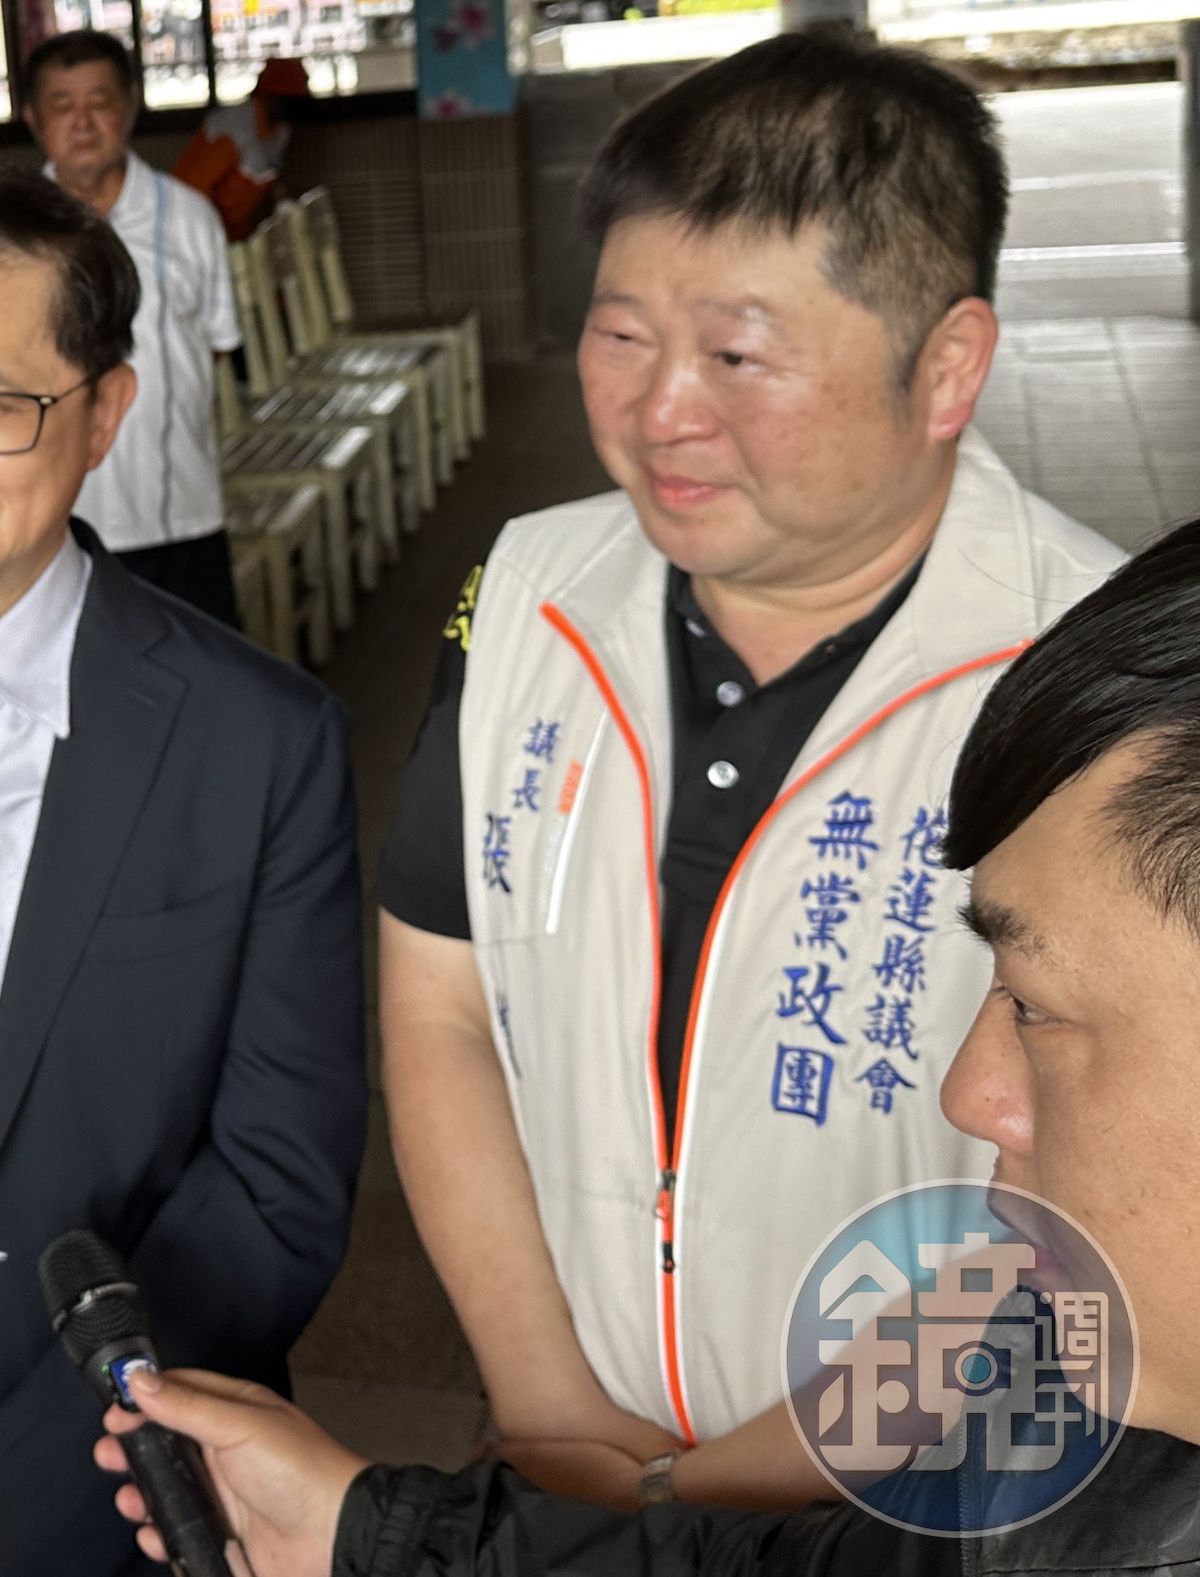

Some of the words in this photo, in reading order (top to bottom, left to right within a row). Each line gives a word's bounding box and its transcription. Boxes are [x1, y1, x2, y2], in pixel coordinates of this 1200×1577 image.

[512, 717, 560, 814] 議長
[771, 789, 880, 1127] 無黨政團
[855, 805, 950, 1115] 花蓮縣議會
